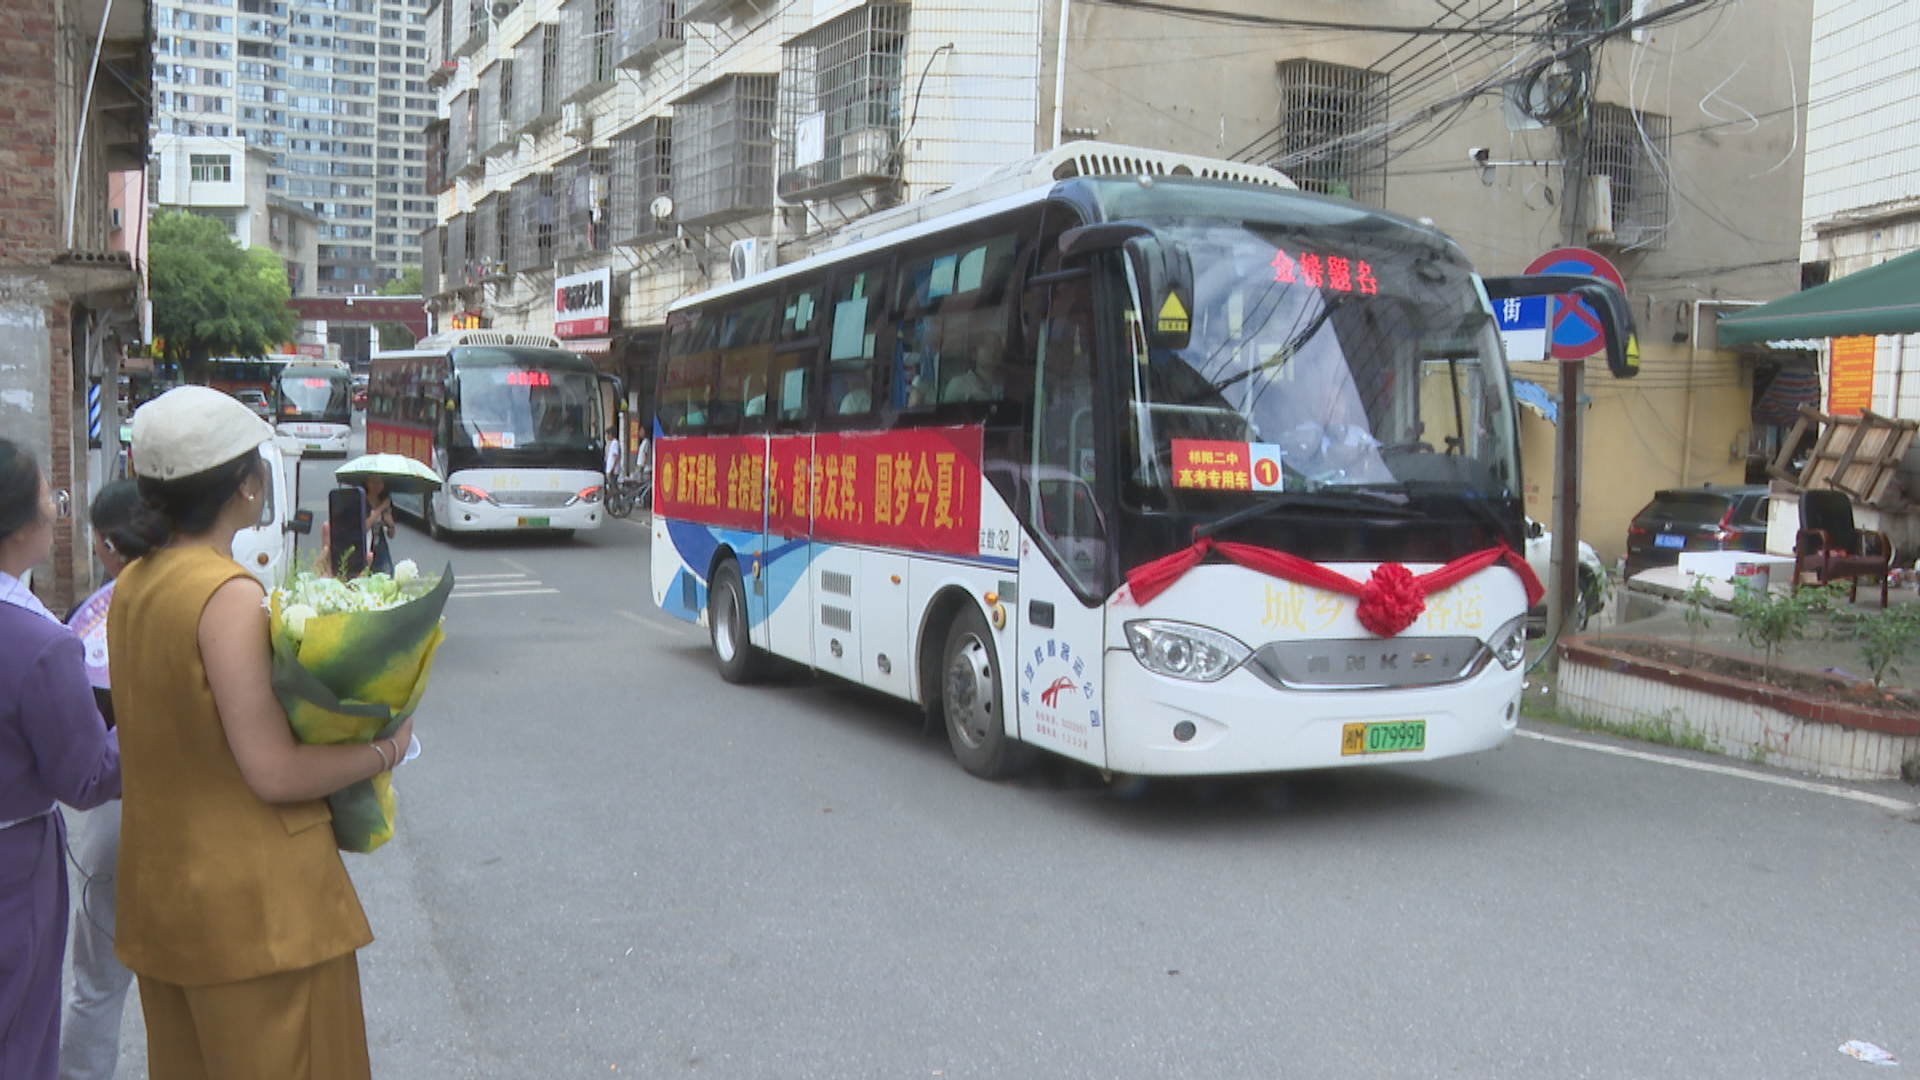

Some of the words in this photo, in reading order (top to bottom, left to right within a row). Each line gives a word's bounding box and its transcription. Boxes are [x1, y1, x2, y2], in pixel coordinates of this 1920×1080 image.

[1270, 248, 1379, 296] 金榜题名
[1503, 297, 1521, 324] 街
[1188, 450, 1239, 466] 祁阳二中
[1178, 468, 1249, 490] 高考专用车
